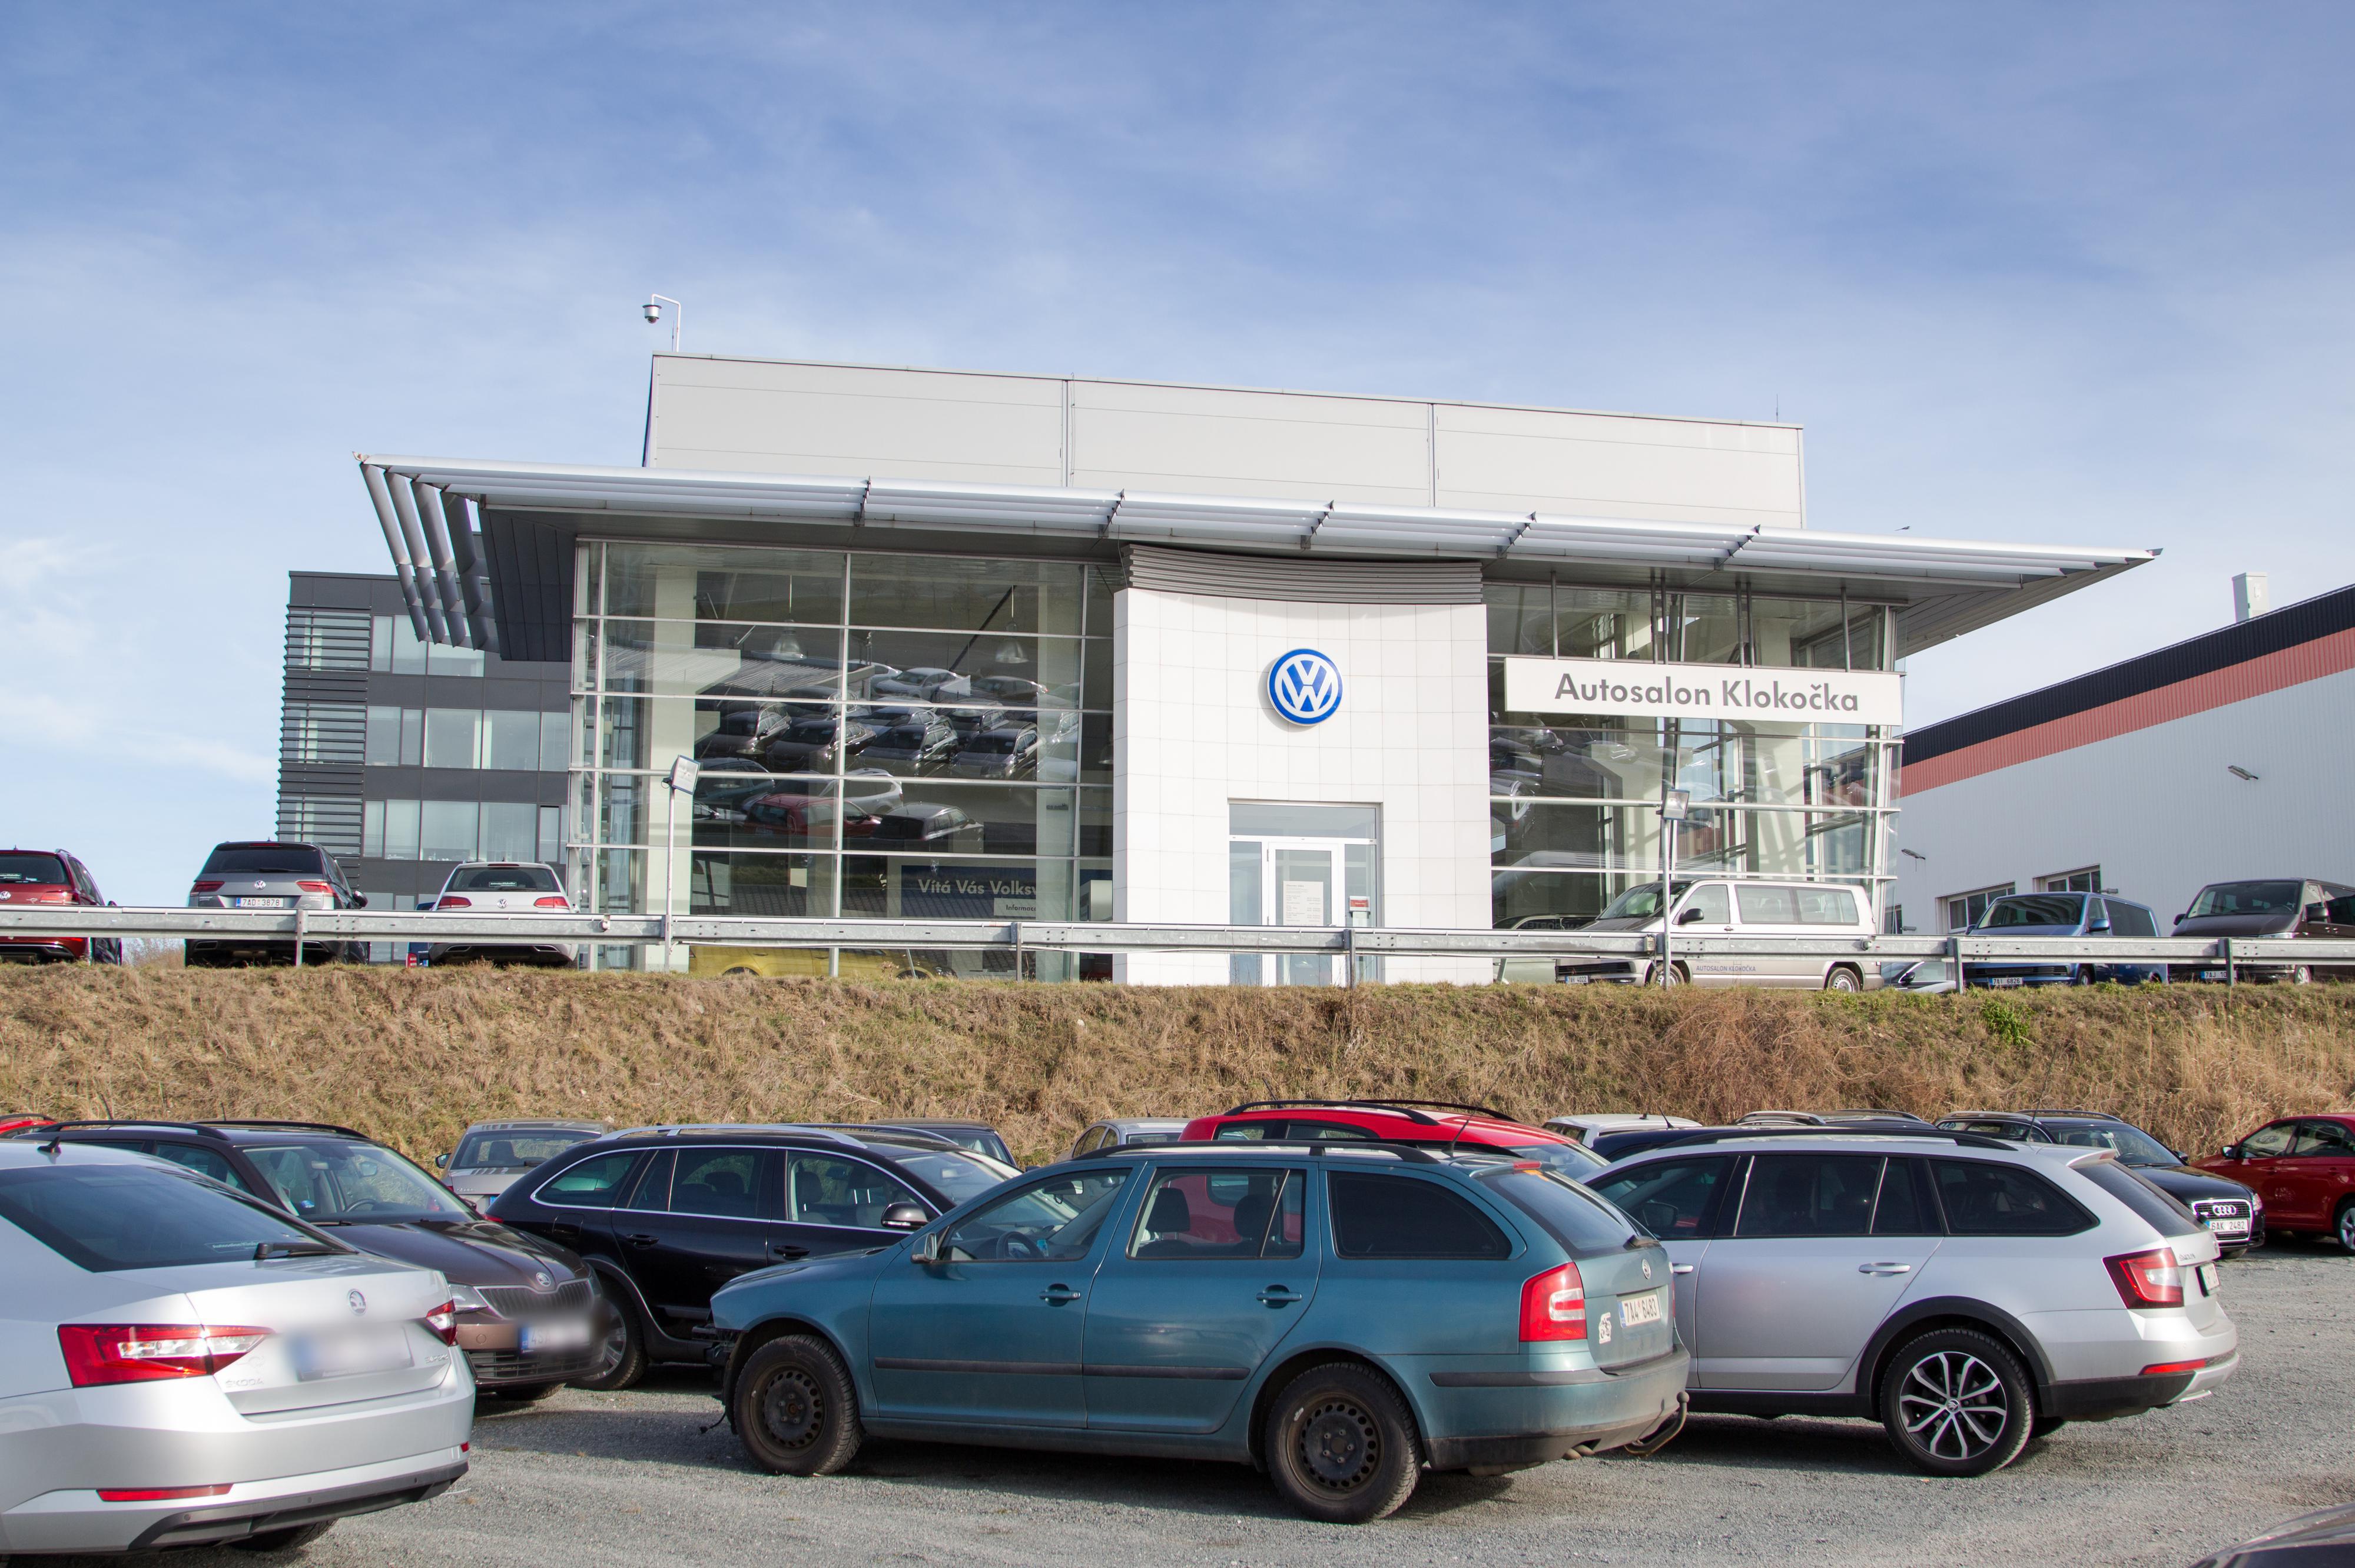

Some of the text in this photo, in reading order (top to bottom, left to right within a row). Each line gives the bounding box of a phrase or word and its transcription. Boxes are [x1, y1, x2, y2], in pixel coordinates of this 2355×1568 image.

[1269, 649, 1342, 724] VW
[1554, 673, 1859, 711] Autosalon Klokočka
[918, 879, 951, 893] Vítá
[956, 880, 984, 894] Vás
[2211, 1221, 2245, 1231] 6AK 2482
[1624, 1298, 1657, 1323] 7A4 6483
